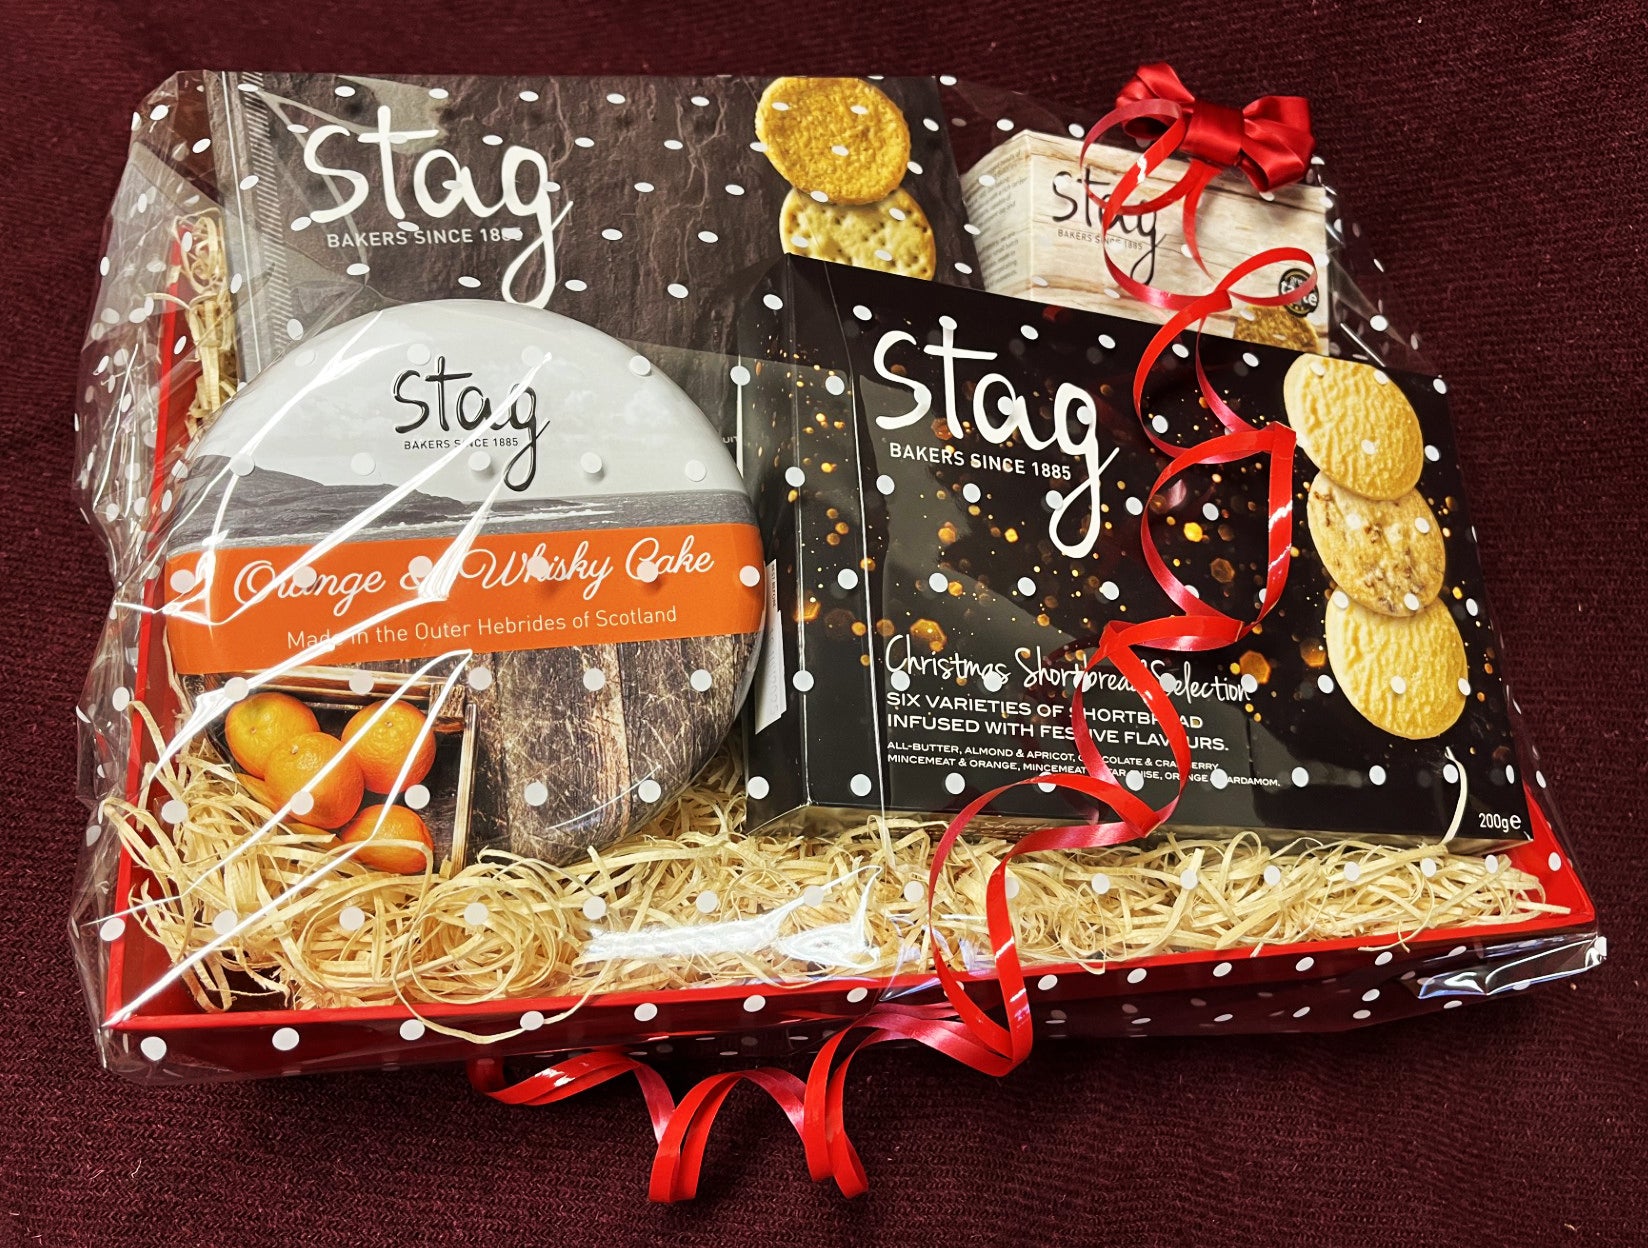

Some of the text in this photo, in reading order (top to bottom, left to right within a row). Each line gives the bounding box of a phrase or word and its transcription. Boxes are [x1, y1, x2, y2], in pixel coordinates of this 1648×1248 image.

[327, 230, 407, 248] BAKERS
[413, 229, 473, 245] SINCE
[1057, 229, 1093, 242] BAKERS
[1094, 234, 1121, 245] SNCE
[404, 437, 519, 450] BAKERS SCE 1885
[889, 442, 1072, 481] BAKERS SINCE 1885
[460, 540, 614, 601] Whisky
[625, 535, 715, 581] Cake
[288, 605, 678, 650] Mad in the Outer Hebrides of Scotland
[885, 634, 1251, 704] Christmas Shortbrea Selection
[886, 691, 1204, 729] SIX VARIETIES OF HORTBAD
[887, 713, 1229, 751] INFUSED WITH FESIVE FLAVURS.
[887, 741, 1219, 770] ALL-BUTTER, ALMOND & APRICOT, CCOLATE & CRAERRY
[887, 754, 956, 767] MINCEMEAT
[957, 758, 967, 767] &
[969, 759, 1021, 771] ORANGE,
[1165, 772, 1209, 782] ORNGE
[1222, 776, 1281, 787] ARDAMOM.
